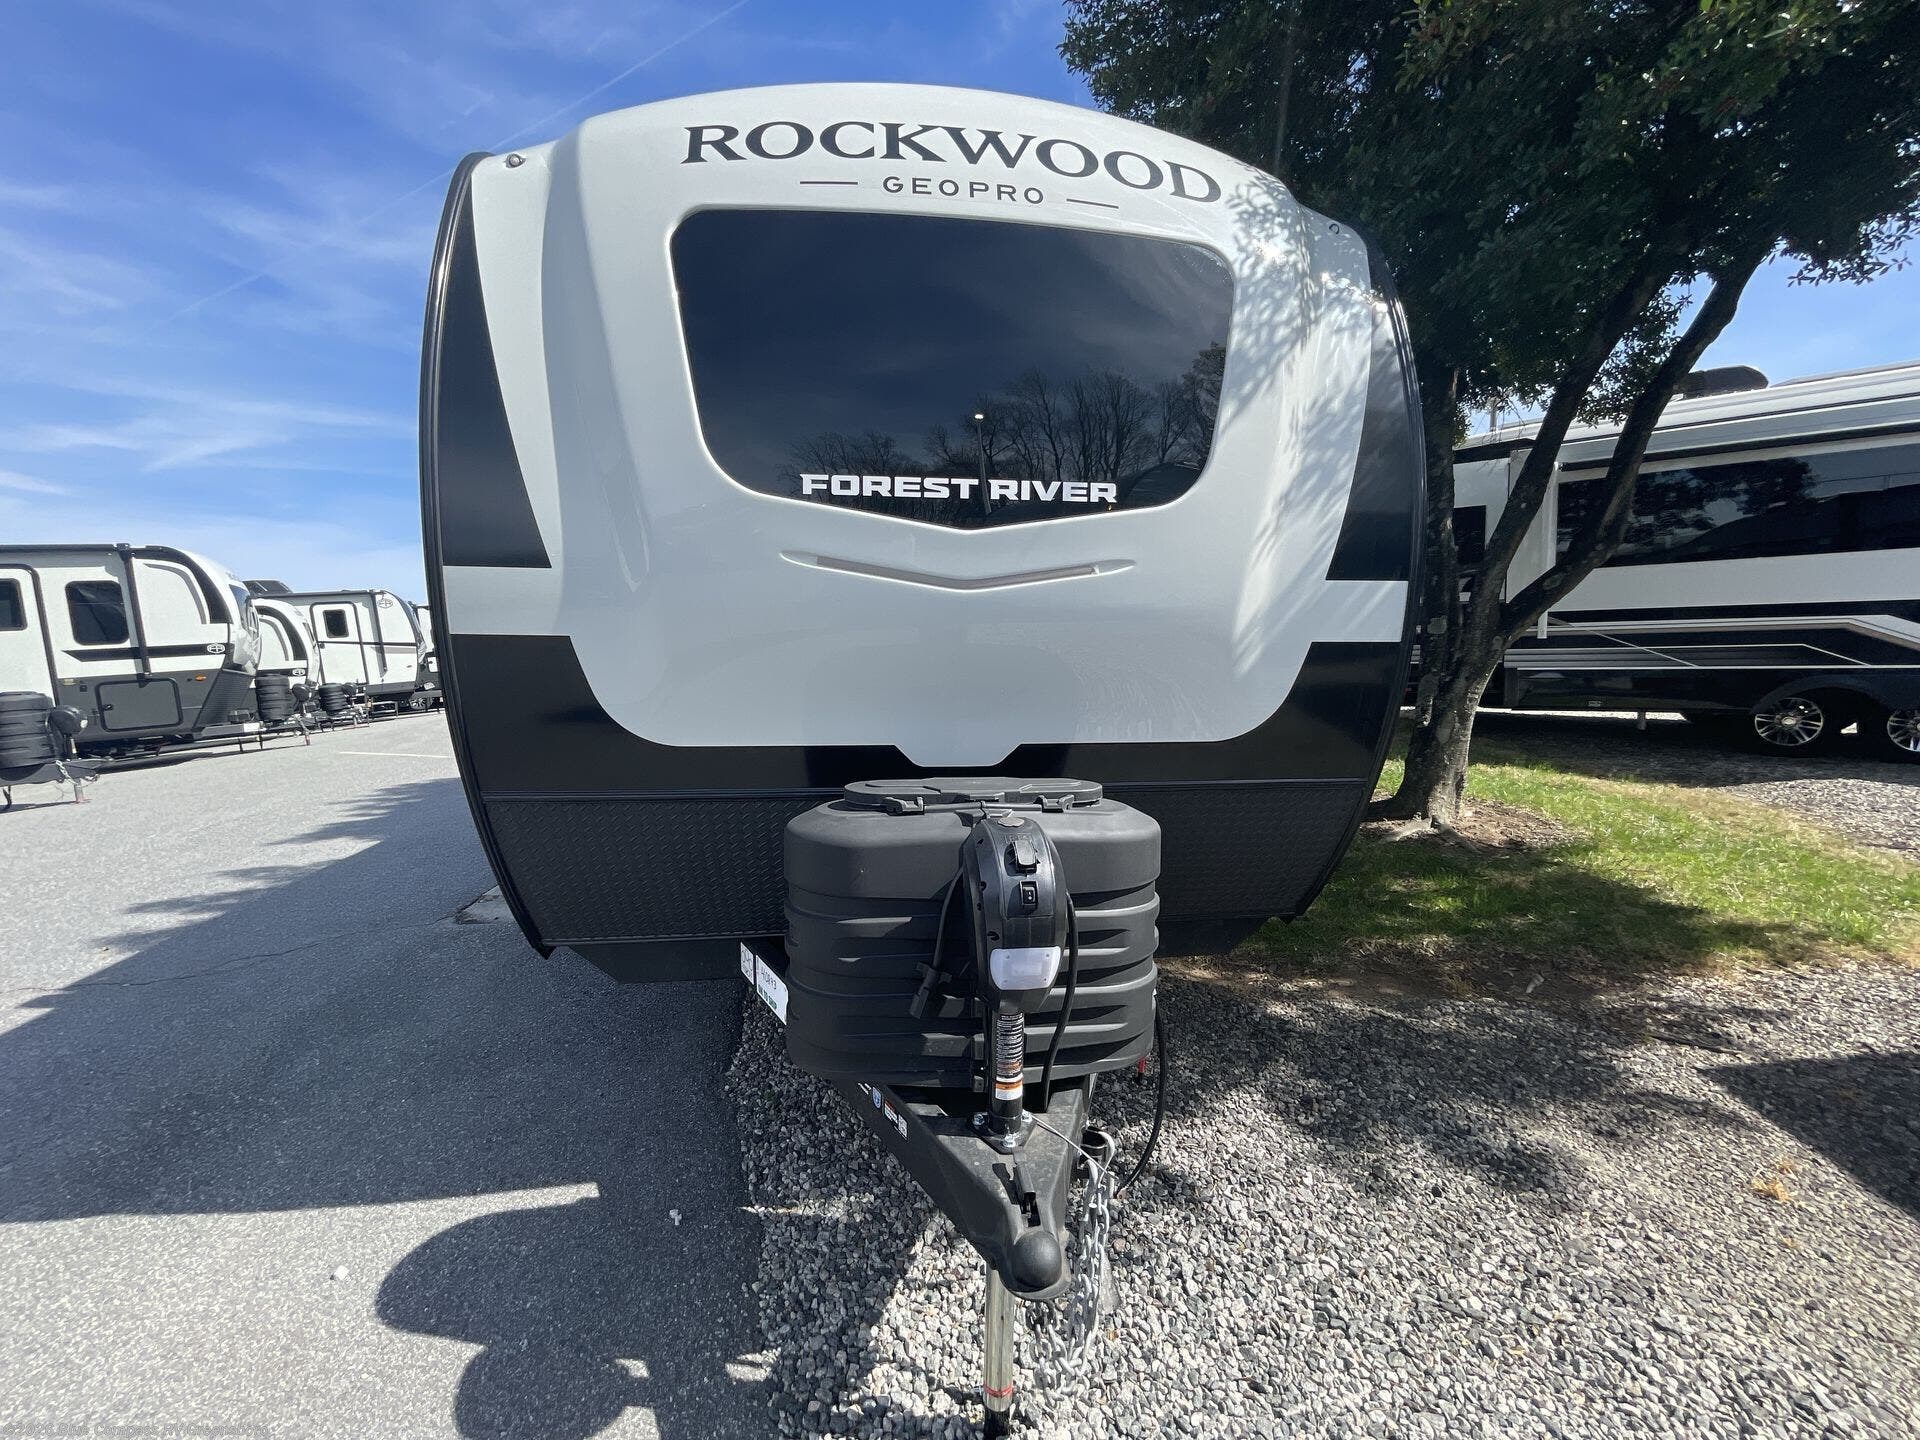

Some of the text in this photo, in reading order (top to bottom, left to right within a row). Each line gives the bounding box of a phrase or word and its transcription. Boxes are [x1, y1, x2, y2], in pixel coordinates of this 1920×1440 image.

[680, 120, 1222, 204] ROCKWOOD
[882, 175, 1045, 205] GEOPRO
[799, 473, 1118, 504] FOREST RIVER
